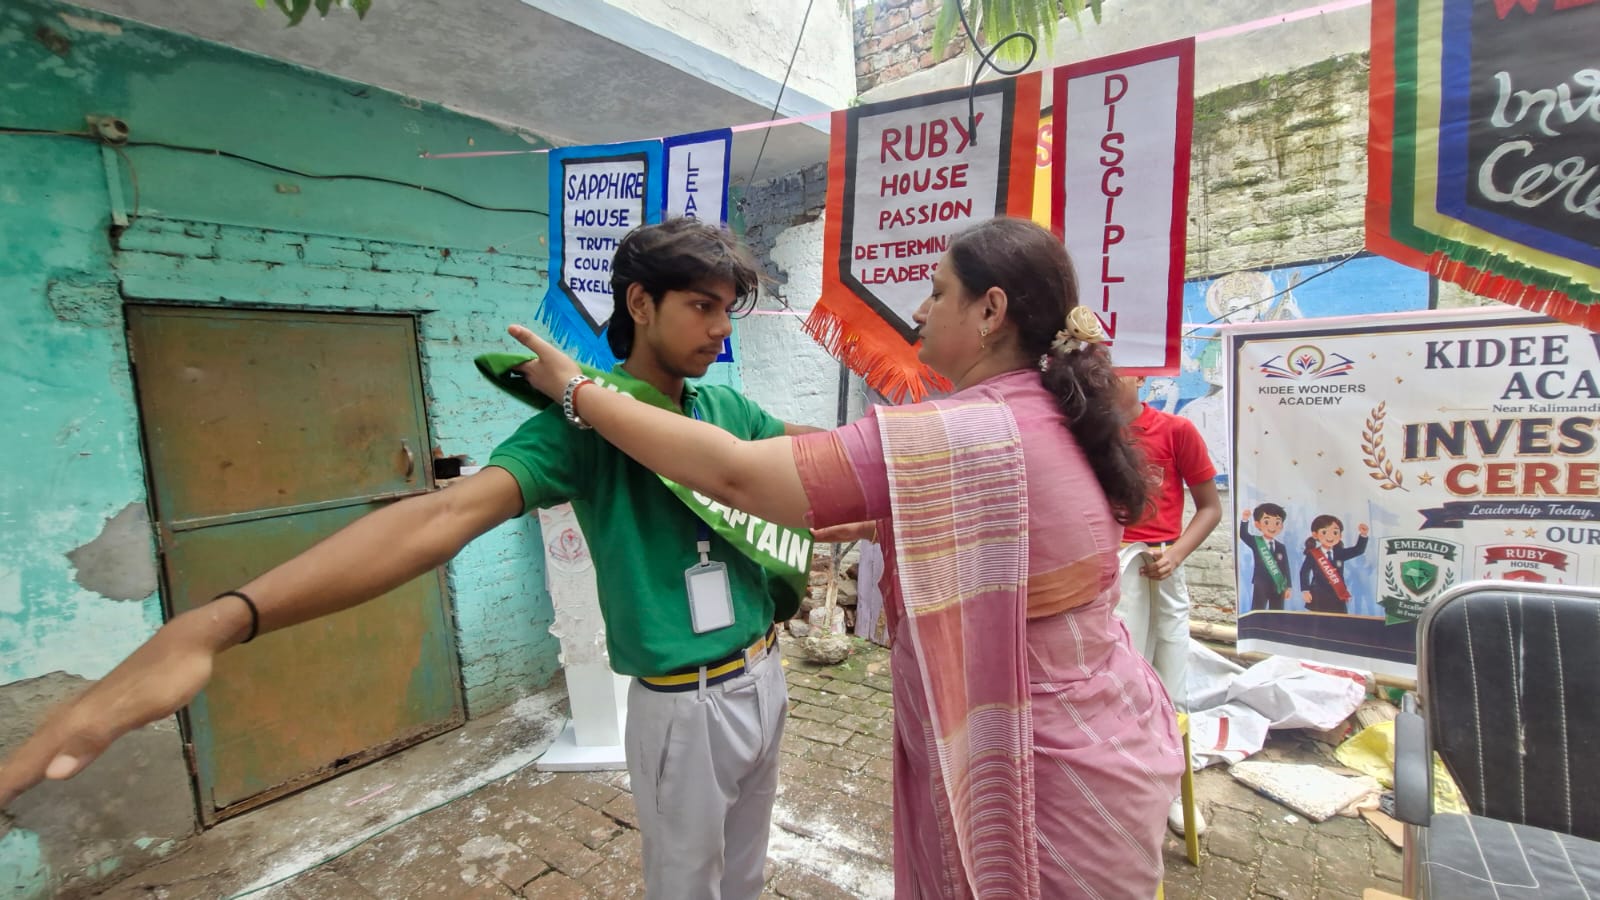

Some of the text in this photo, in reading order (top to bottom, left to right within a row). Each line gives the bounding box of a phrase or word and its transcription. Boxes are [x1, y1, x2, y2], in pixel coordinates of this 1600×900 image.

[880, 112, 985, 164] RUBY
[567, 172, 644, 200] SAPPHIRE
[880, 163, 969, 197] HOUSE
[574, 209, 630, 227] HOUSE
[879, 198, 973, 230] PASSION
[1094, 73, 1128, 346] DISCIPLIN
[854, 234, 950, 260] DETERMIN
[574, 257, 614, 273] COUR
[1424, 334, 1569, 369] KIDEE
[1258, 384, 1366, 395] KIDEE WONDERS
[1500, 369, 1600, 400] ACA
[1278, 396, 1342, 406] ACADEMY
[1492, 404, 1525, 413] Near
[1402, 416, 1600, 462] INVES
[1444, 462, 1600, 496] CERE
[1470, 503, 1542, 518] Leadership
[1393, 540, 1449, 554] EMERALD
[1407, 551, 1433, 560] HOUSE
[1505, 549, 1547, 560] RUBY
[1260, 547, 1279, 576] LEADER
[1318, 556, 1340, 585] LEADER
[1510, 561, 1540, 569] HOUSE
